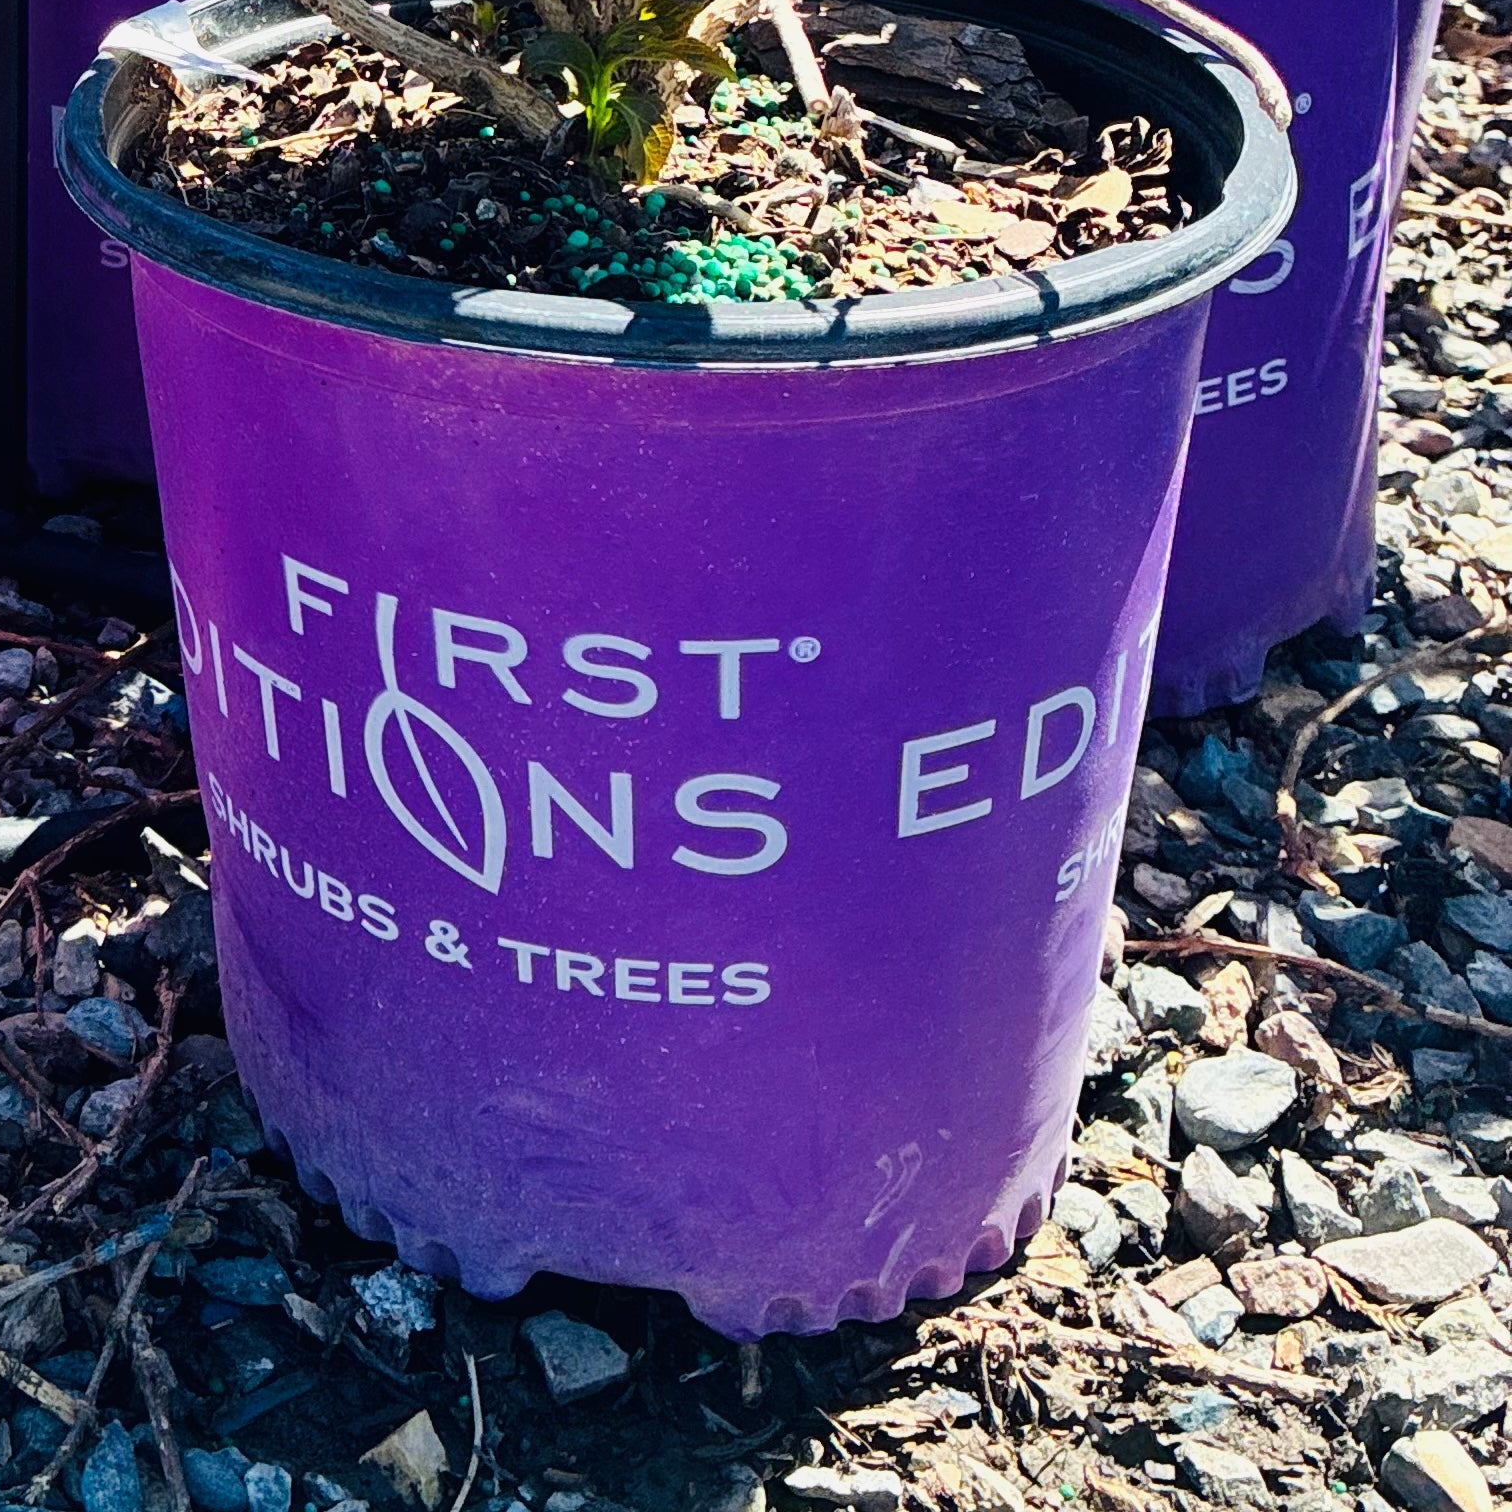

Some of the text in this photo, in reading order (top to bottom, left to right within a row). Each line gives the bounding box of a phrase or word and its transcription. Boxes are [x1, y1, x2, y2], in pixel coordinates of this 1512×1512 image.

[1195, 358, 1289, 416] EES
[169, 556, 789, 896] DITIONS
[208, 771, 772, 1006] SHRUBS & TREES
